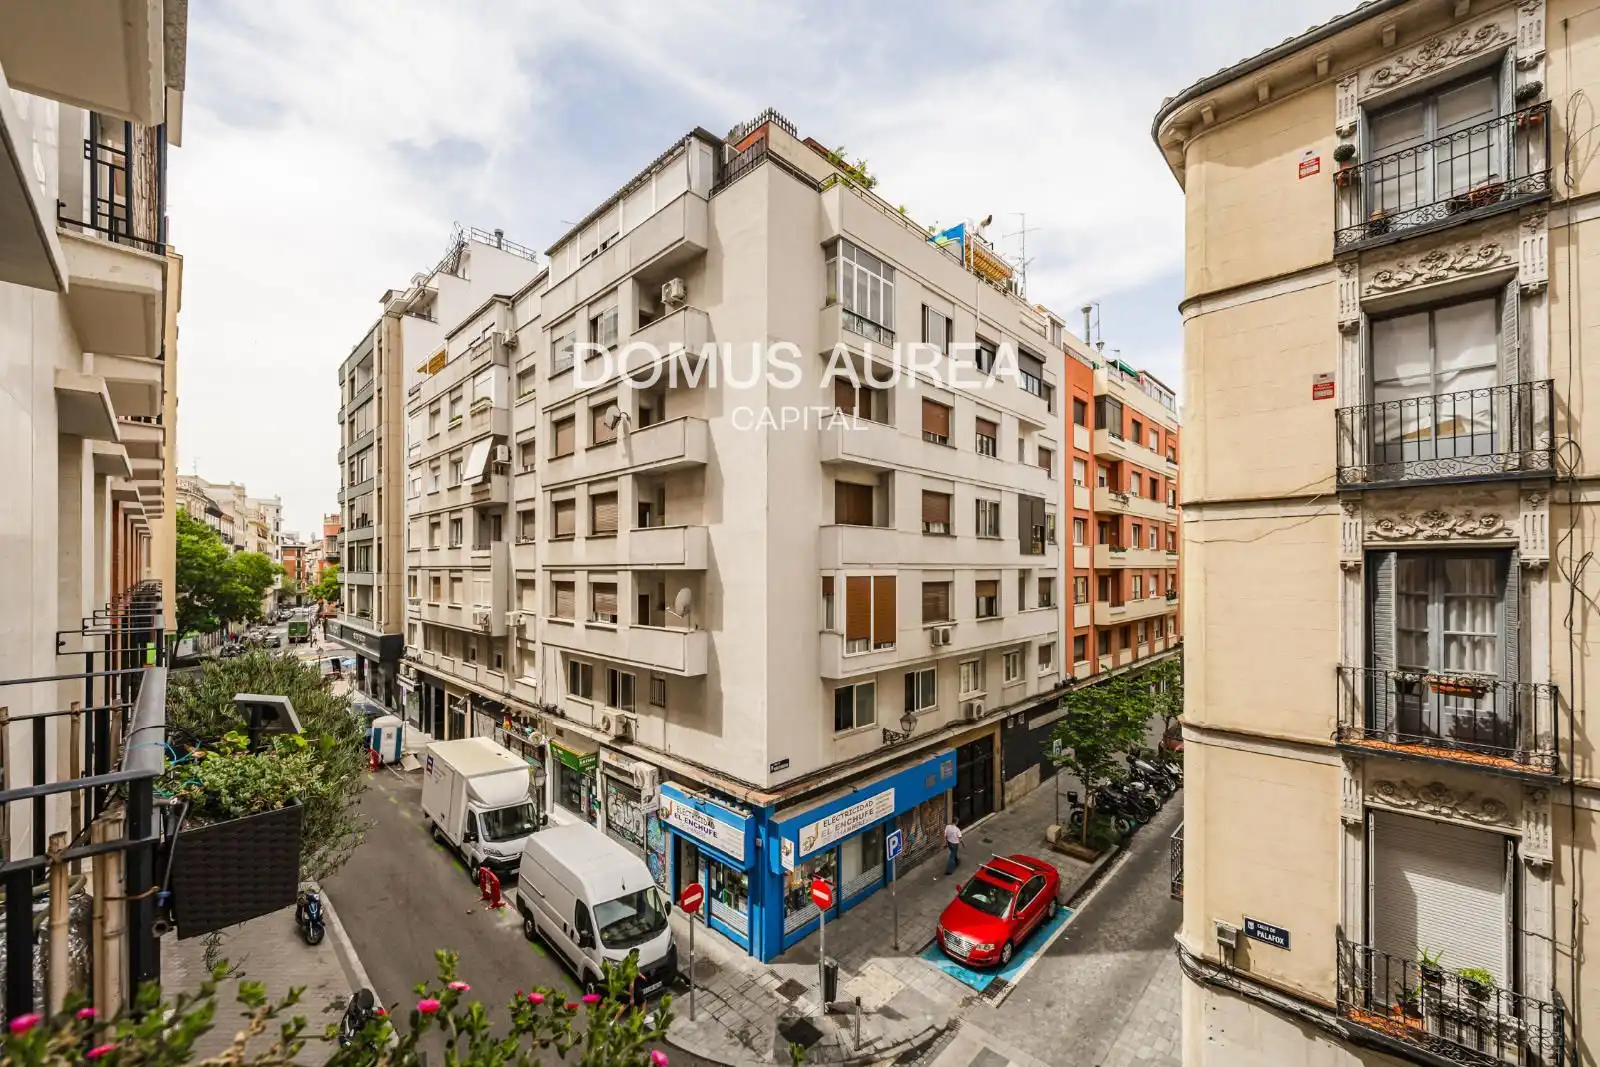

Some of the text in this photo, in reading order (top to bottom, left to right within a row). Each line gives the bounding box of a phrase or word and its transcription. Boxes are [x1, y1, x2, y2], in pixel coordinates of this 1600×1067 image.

[674, 812, 683, 822] EL
[684, 817, 719, 839] ENCHUFE
[676, 805, 716, 830] ELECTRICIDAD
[821, 808, 875, 838] EL ENCHUFE
[823, 800, 875, 828] ELECTRICIDAD
[889, 834, 899, 857] P
[1257, 930, 1285, 945] PALAFOX
